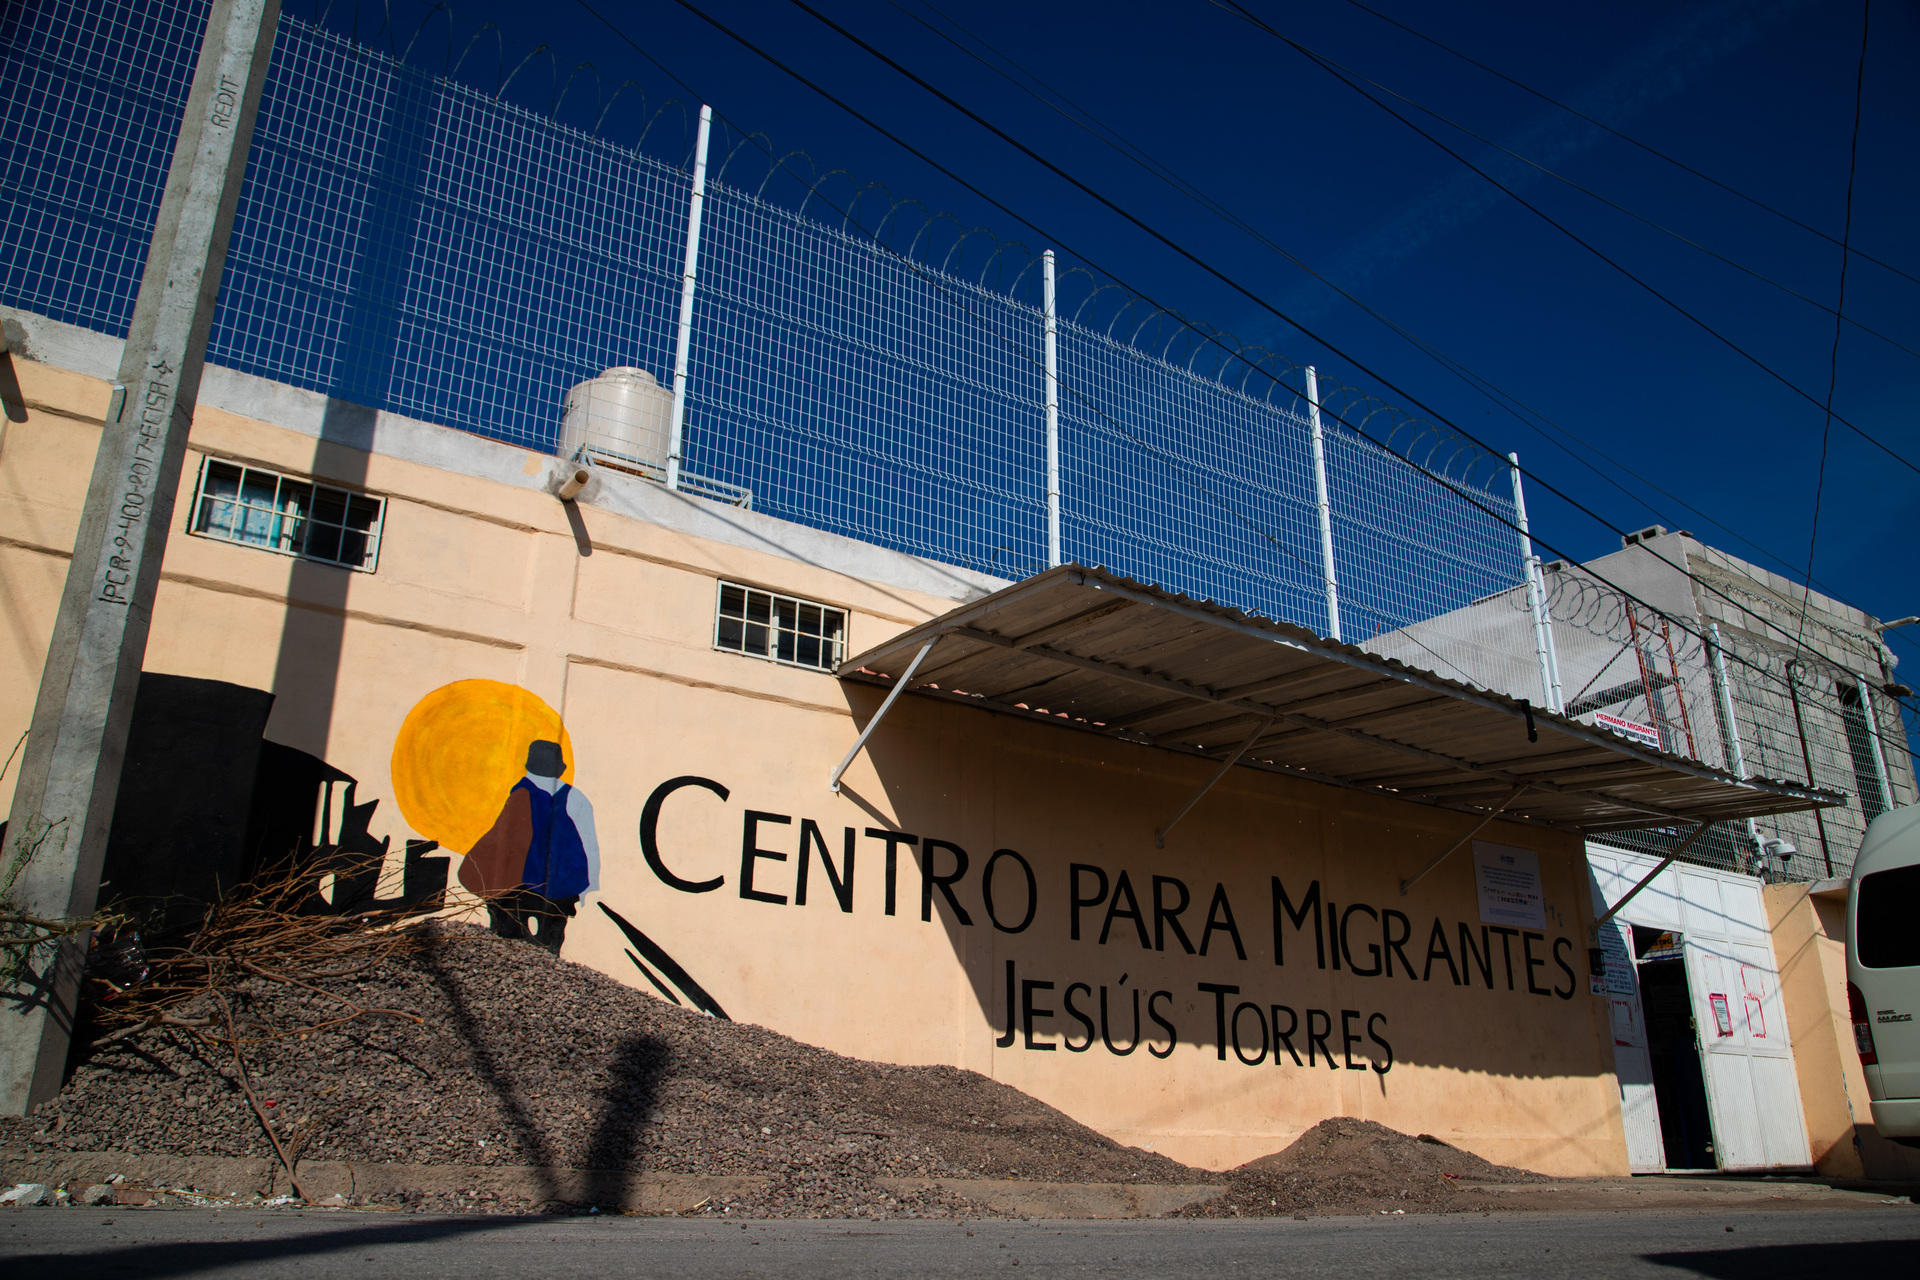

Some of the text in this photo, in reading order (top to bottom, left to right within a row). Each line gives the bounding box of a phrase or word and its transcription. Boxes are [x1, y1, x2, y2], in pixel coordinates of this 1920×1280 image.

[1595, 712, 1626, 727] HERMANO
[1626, 721, 1658, 736] MIGRANTE
[640, 775, 1577, 1000] CENTRO PARA MIGRANTES
[996, 960, 1394, 1075] JESÚS TORRES
